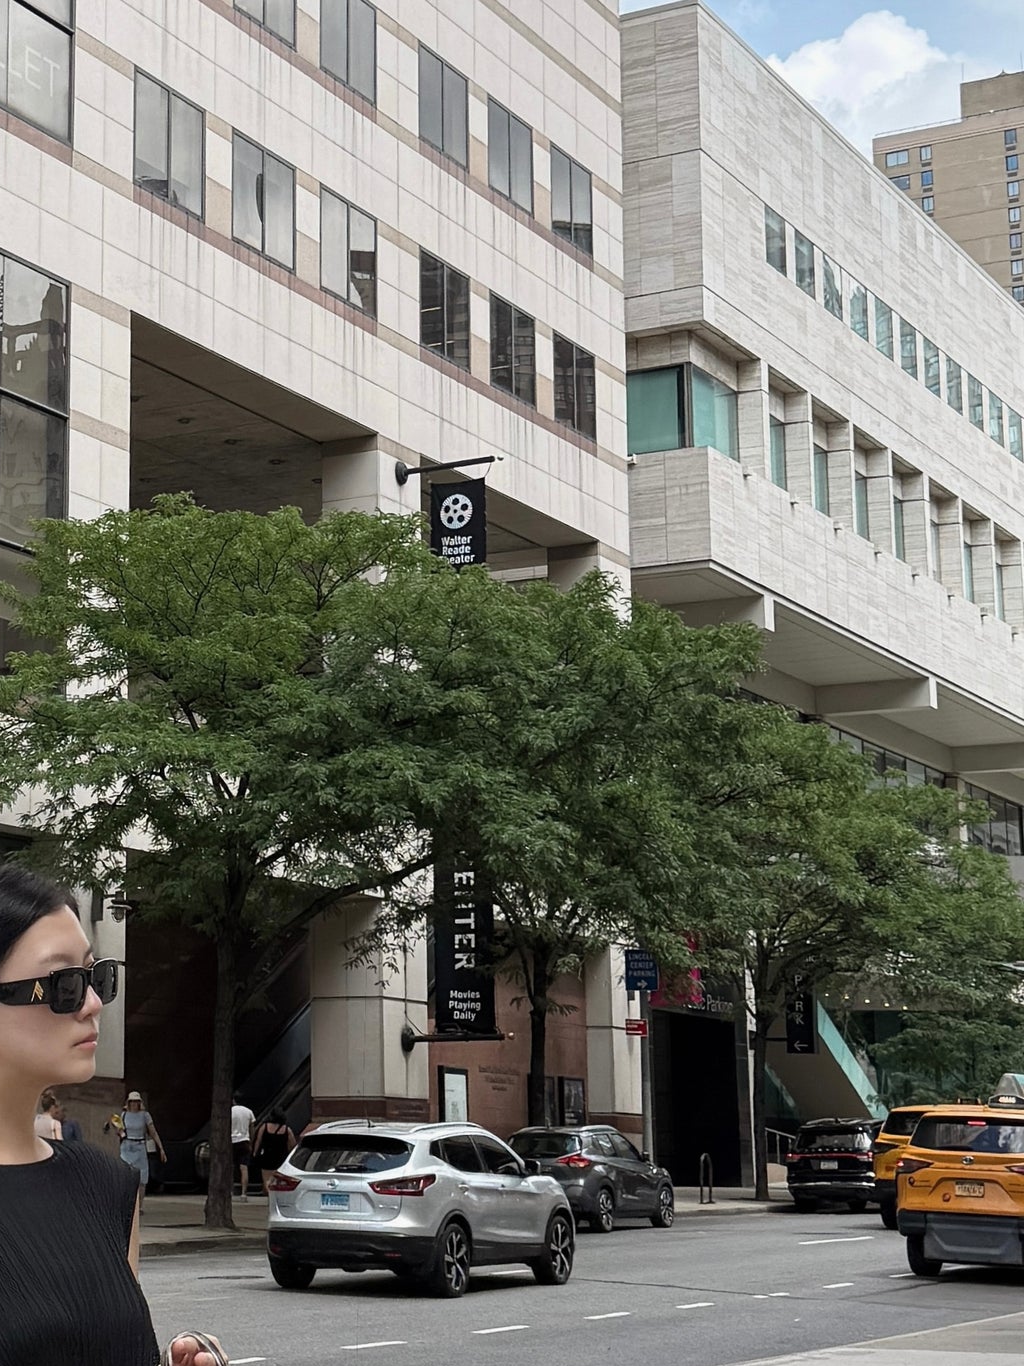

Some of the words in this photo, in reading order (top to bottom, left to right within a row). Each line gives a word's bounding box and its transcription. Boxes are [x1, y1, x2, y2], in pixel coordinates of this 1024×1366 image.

[441, 536, 472, 545] Walter
[442, 546, 471, 555] Reade
[439, 555, 475, 564] eater
[450, 990, 481, 999] Movies
[449, 1000, 481, 1011] Playing
[453, 1011, 476, 1021] Daily
